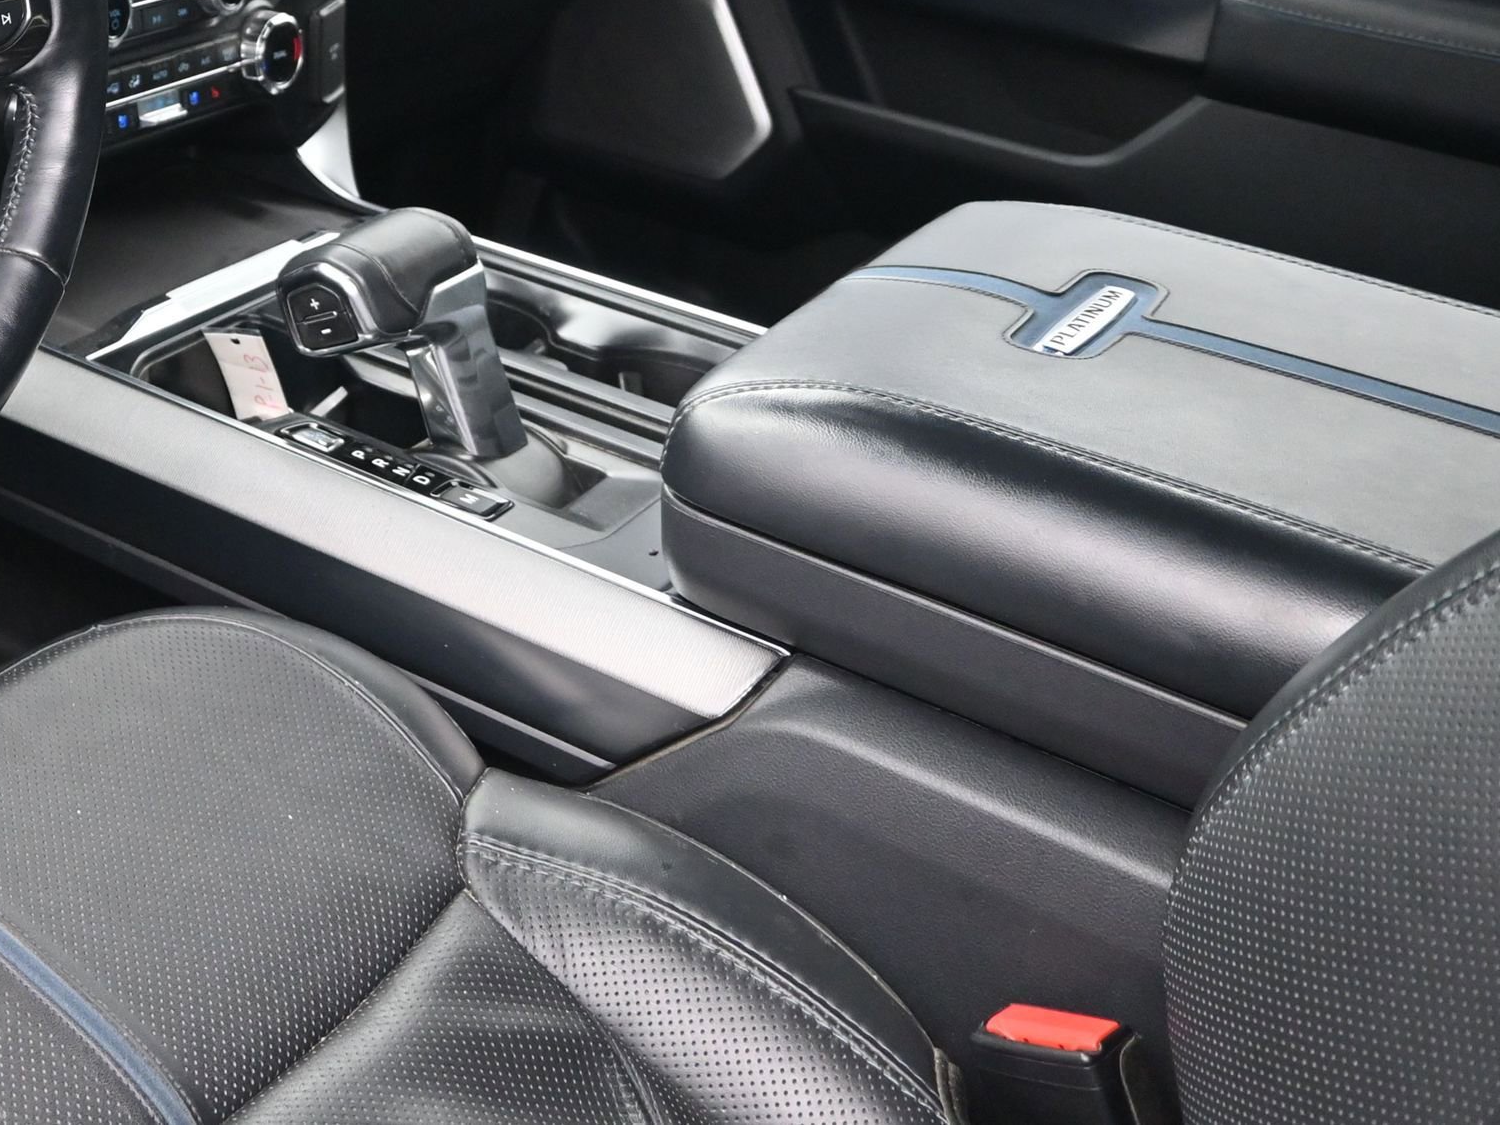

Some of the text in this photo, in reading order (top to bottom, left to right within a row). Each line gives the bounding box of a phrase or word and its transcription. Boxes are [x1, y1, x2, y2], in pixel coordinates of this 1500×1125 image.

[1049, 289, 1123, 347] PLATINUM
[350, 449, 431, 486] P R N D
[459, 493, 480, 505] M
